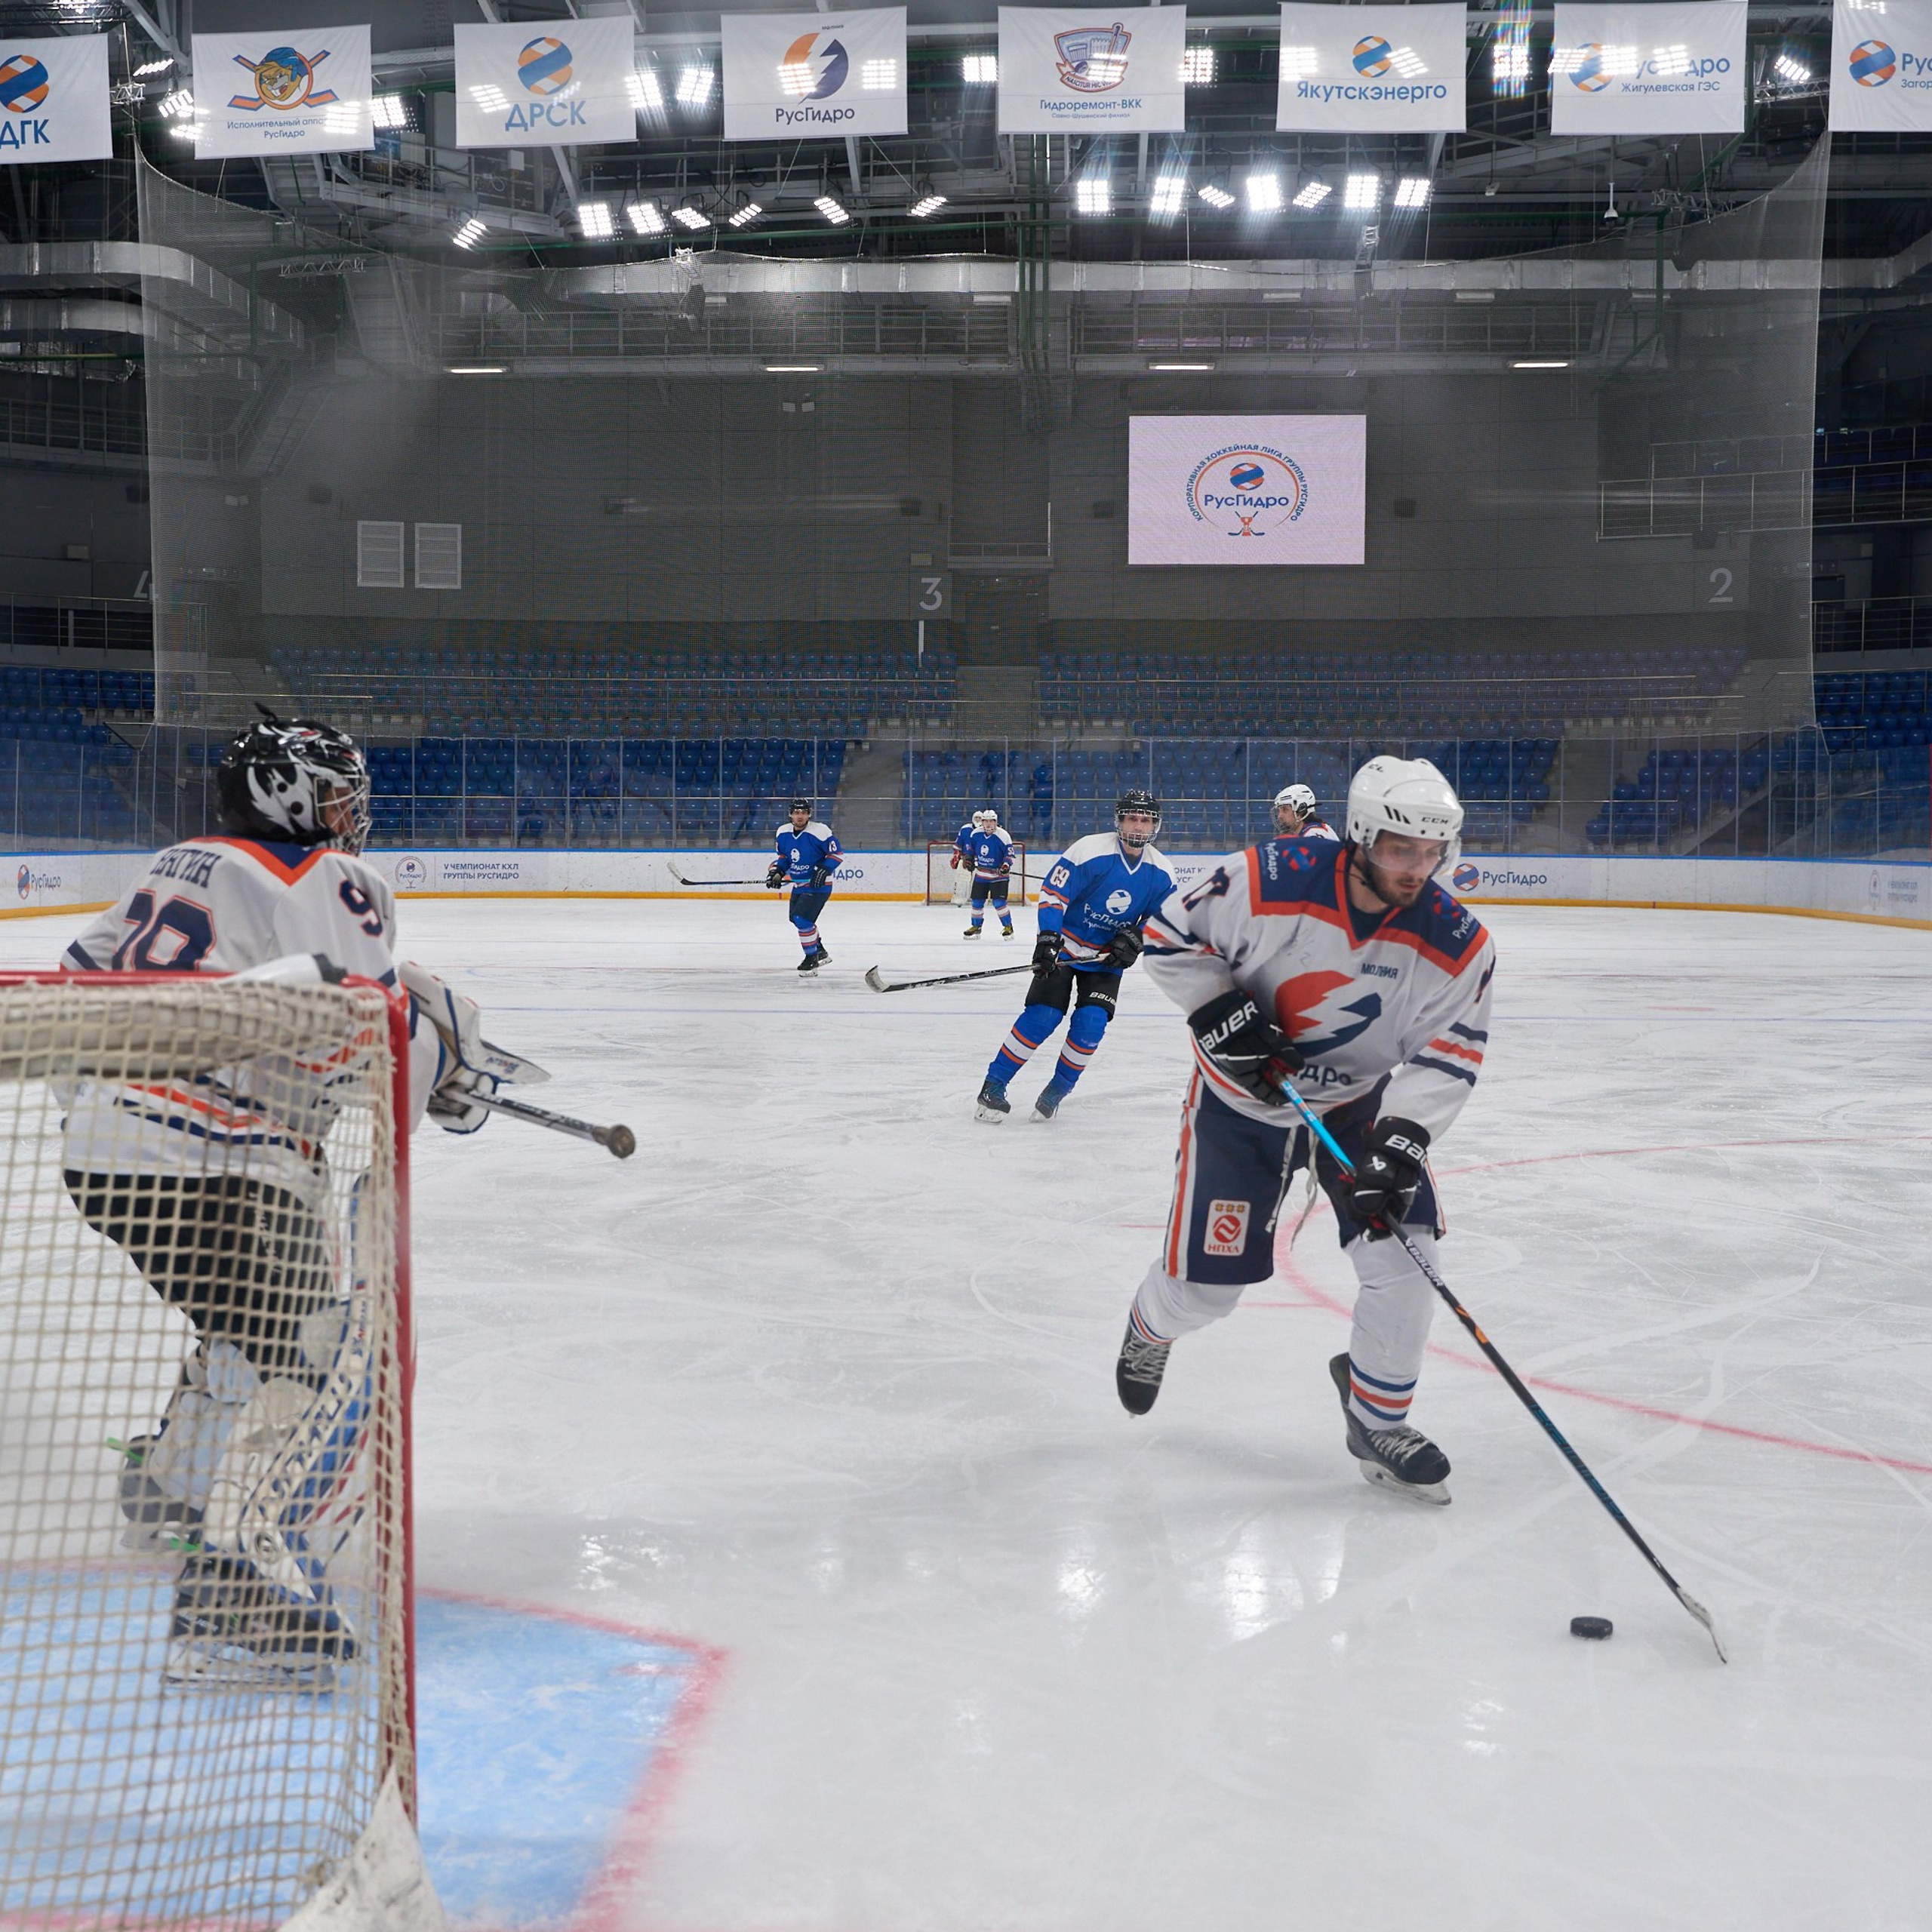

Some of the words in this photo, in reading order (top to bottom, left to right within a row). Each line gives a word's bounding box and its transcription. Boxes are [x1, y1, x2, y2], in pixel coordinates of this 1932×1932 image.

[1297, 80, 1447, 103] Якутскэнерго
[1622, 82, 1695, 94] Жигулевская
[1698, 81, 1721, 91] ГЭС
[1040, 98, 1143, 112] Гидроремонт-ВКК
[227, 118, 300, 129] Исполнительный
[505, 100, 586, 132] ДРСК
[775, 107, 855, 125] РусГидро
[0, 118, 51, 149] ДГК
[264, 129, 306, 139] РусГидро
[1205, 443, 1259, 463] ХОККЕЙНАЯ
[1260, 446, 1283, 459] ЛИГА
[1282, 456, 1306, 483] ГРУППЫ
[1186, 460, 1207, 521] КОРПОРАТИВНАЯ
[1204, 494, 1290, 509] РусГидро
[1290, 484, 1308, 521] РУСГИДРО
[919, 577, 943, 611] 3
[1709, 568, 1734, 603] 2
[1421, 816, 1449, 824] CCM
[829, 840, 838, 852] 13
[1050, 865, 1070, 888] 69
[1482, 871, 1547, 886] РусГидро
[1361, 963, 1398, 979] МОЛНИЯ
[1089, 992, 1117, 1006] BAUE
